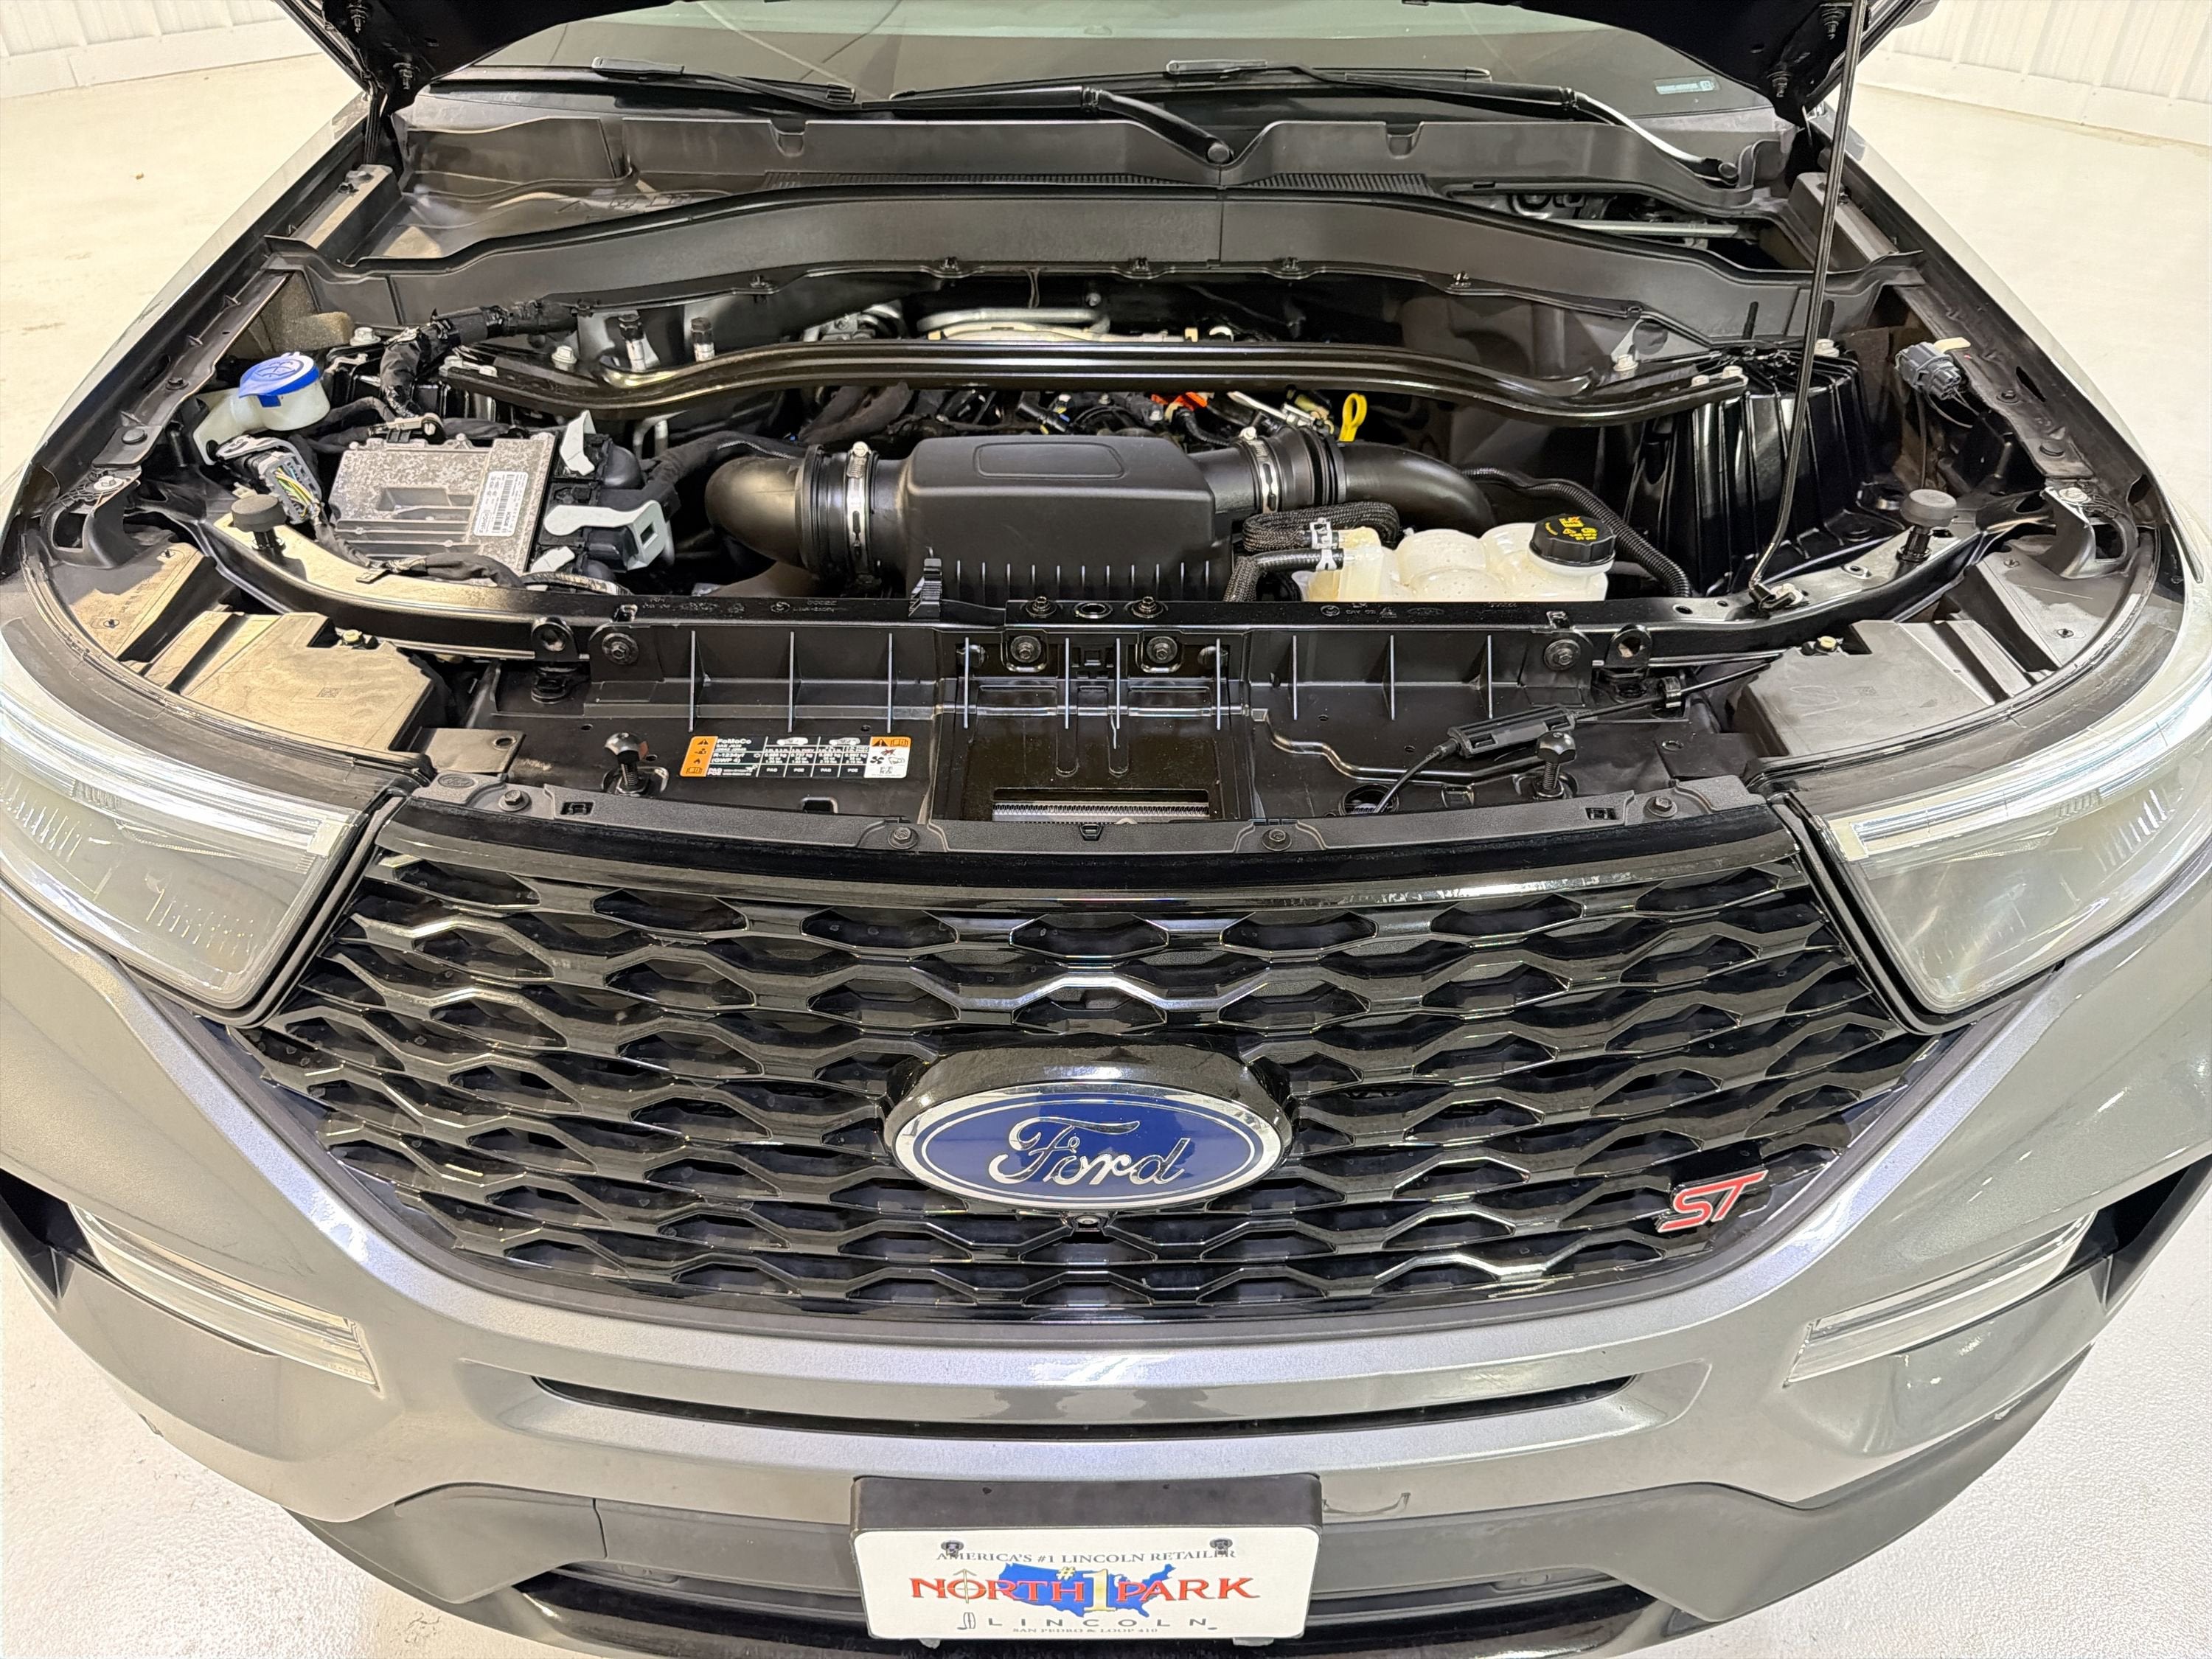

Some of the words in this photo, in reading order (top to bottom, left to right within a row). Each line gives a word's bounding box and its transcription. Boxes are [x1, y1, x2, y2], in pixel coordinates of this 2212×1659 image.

[988, 1116, 1191, 1186] Ford
[1657, 1169, 1770, 1234] ST
[1062, 1553, 1145, 1563] LINCOLN
[909, 1576, 1085, 1603] NORTH
[1116, 1576, 1261, 1602] PARK
[988, 1618, 1207, 1627] LINCOLN
